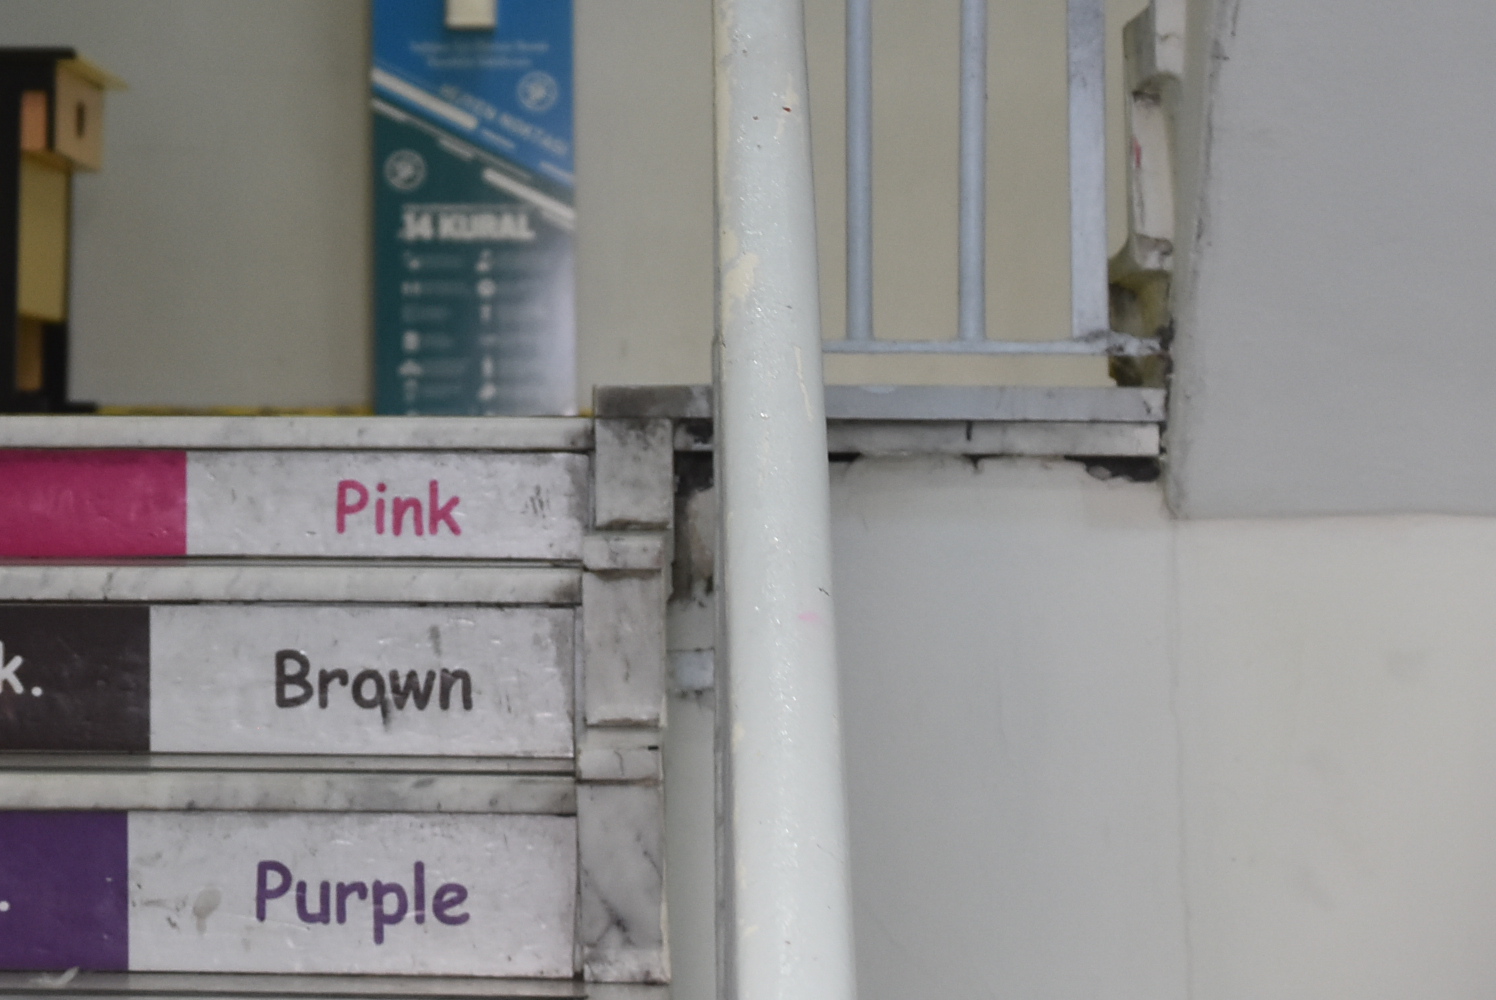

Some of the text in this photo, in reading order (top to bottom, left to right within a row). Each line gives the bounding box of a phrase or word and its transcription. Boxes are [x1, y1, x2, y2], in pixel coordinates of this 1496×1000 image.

[335, 479, 462, 538] Pink
[274, 649, 473, 711] Brown
[254, 860, 471, 946] Purple
